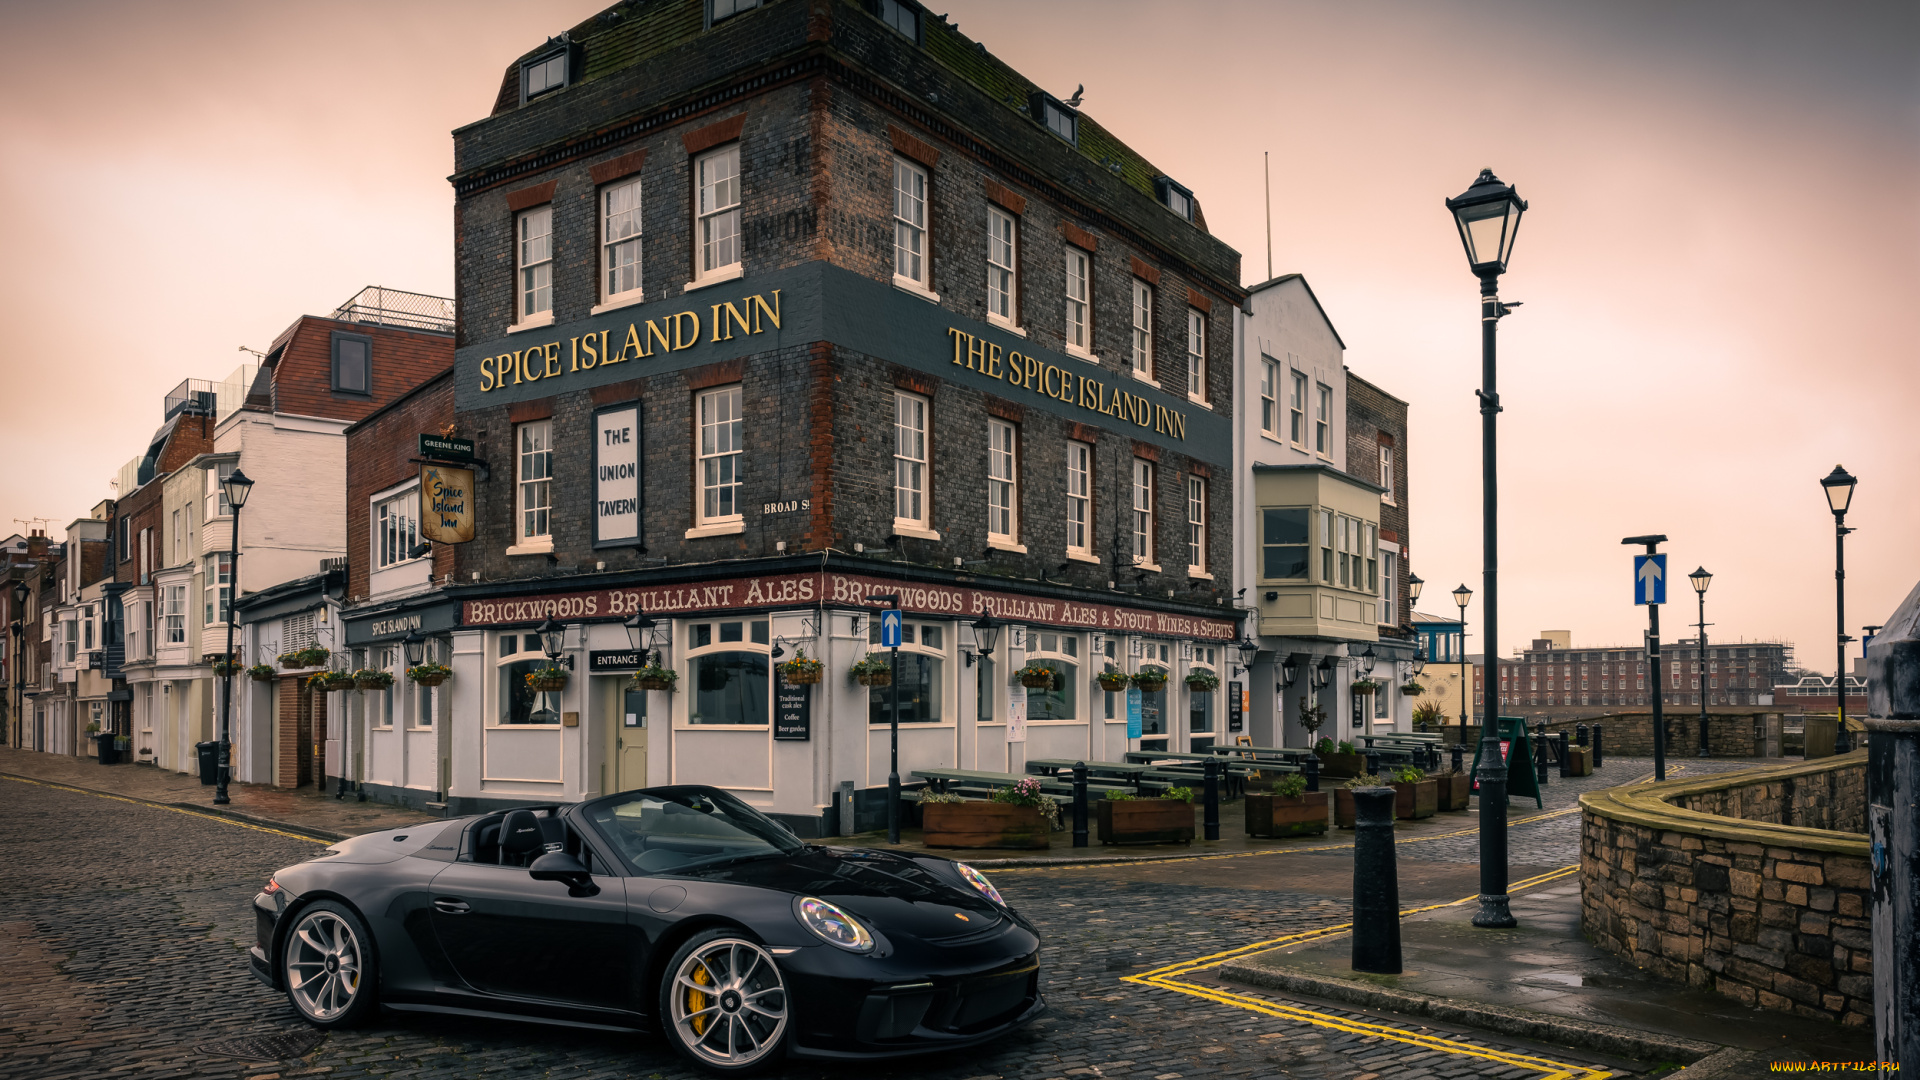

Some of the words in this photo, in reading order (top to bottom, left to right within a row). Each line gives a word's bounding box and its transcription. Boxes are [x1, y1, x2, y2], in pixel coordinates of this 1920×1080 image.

[479, 341, 562, 392] SPICE
[570, 310, 701, 372] ISLAND
[710, 289, 782, 343] INN
[948, 326, 1004, 380] THE
[1008, 350, 1074, 404] SPICE
[1077, 375, 1152, 428] ISLAND
[1155, 404, 1187, 442] INN
[424, 439, 453, 450] GREENE
[453, 443, 472, 452] KING
[604, 427, 630, 446] THE
[599, 462, 635, 482] UNION
[433, 481, 464, 501] Spice
[432, 497, 465, 515] Island
[598, 497, 637, 517] TAVERN
[763, 500, 798, 515] BROAD
[440, 513, 458, 528] Inn
[469, 594, 598, 624] BRICKWOODS
[608, 584, 734, 614] BRILLIANT
[744, 577, 815, 605] ALES
[831, 575, 963, 612] BRICKWOODS
[970, 591, 1056, 621] BRILLIANT
[1060, 602, 1098, 625] ALES
[1101, 610, 1110, 626] &
[1156, 612, 1191, 634] WINES
[1192, 621, 1199, 635] &
[1200, 619, 1235, 639] SPIRITS
[372, 620, 387, 637] SPICE
[387, 616, 409, 634] ISLAND
[596, 654, 639, 666] ENTRANCE
[790, 725, 805, 733] garden
